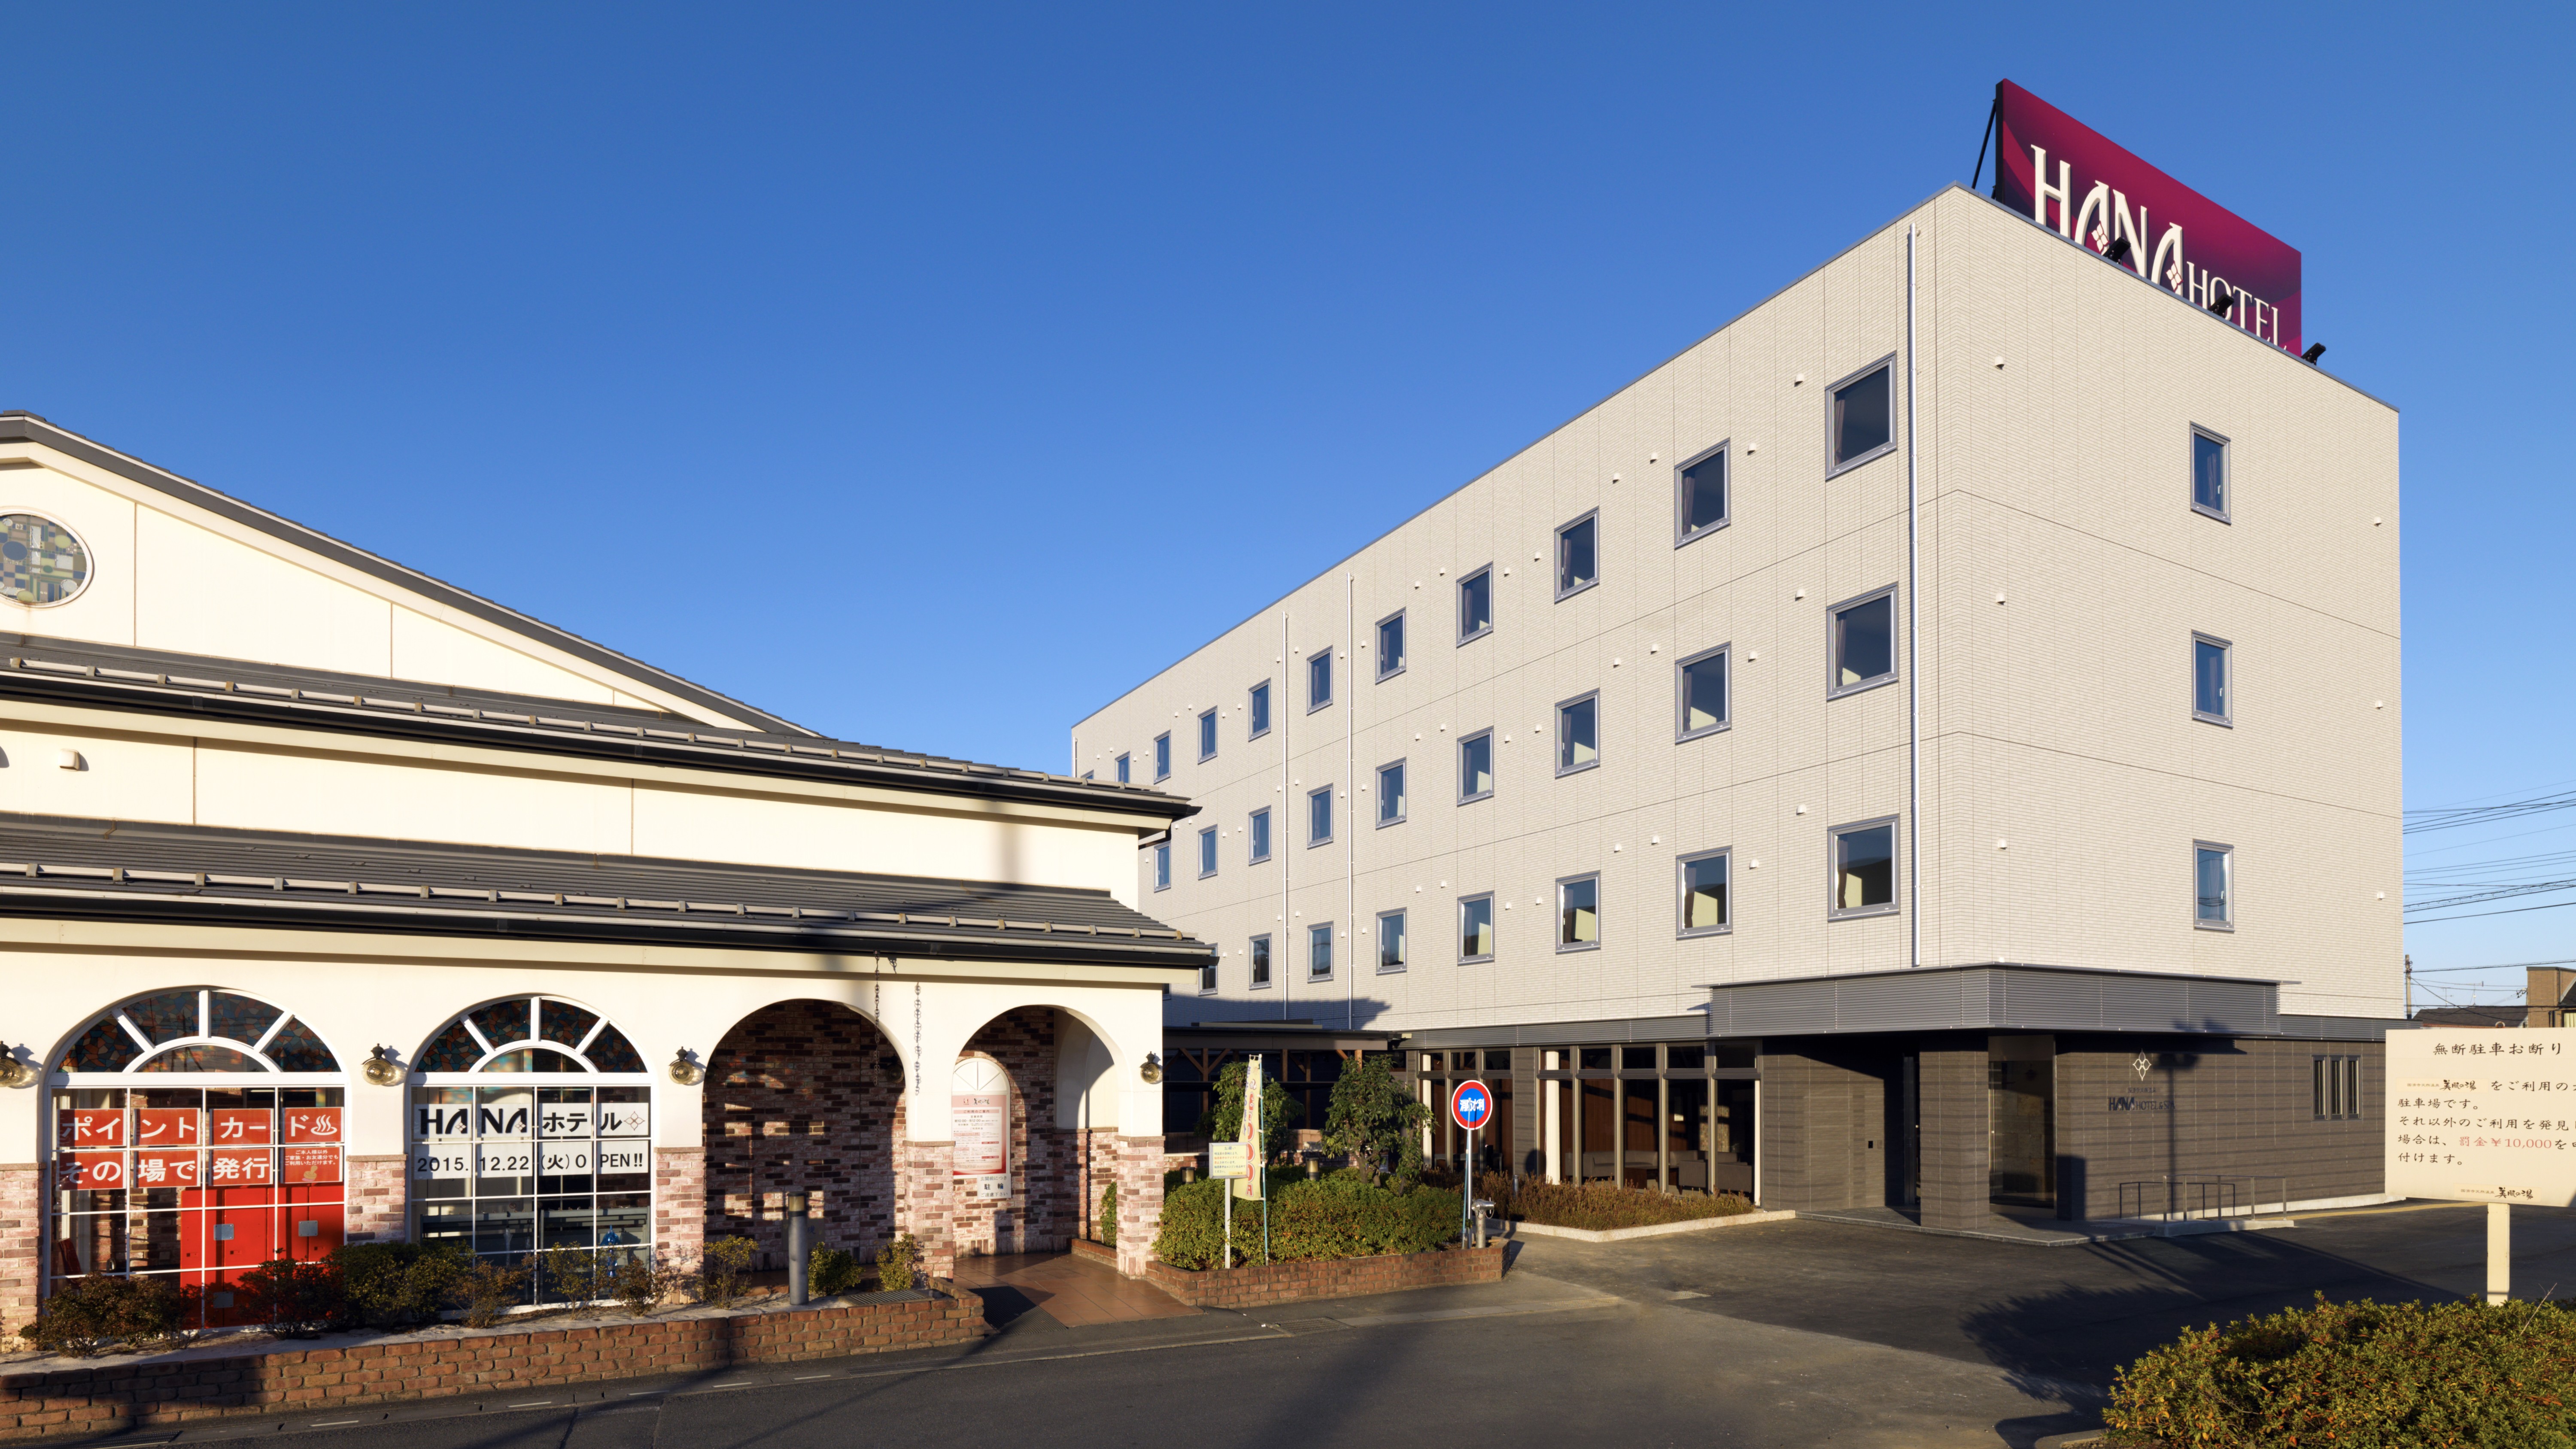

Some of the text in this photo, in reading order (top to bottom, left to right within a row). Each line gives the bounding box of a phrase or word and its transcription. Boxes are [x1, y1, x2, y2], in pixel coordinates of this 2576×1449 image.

[2031, 144, 2287, 350] HANA HOTEL
[2433, 1042, 2561, 1056] 無断駐車お断り
[2439, 1079, 2476, 1091] 美肌の湯
[1460, 1098, 1485, 1112] 消防水利
[2108, 1097, 2135, 1111] HANA
[2398, 1097, 2478, 1110] 駐車場です。
[62, 1115, 310, 1140] ポイントカード
[418, 1108, 623, 1134] HANA ホテル
[2400, 1116, 2576, 1131] それ以外のご利用を発見
[2398, 1152, 2462, 1165] 付けます。
[60, 1157, 270, 1184] その場で発行
[2494, 1187, 2533, 1200] 美肌の湯
